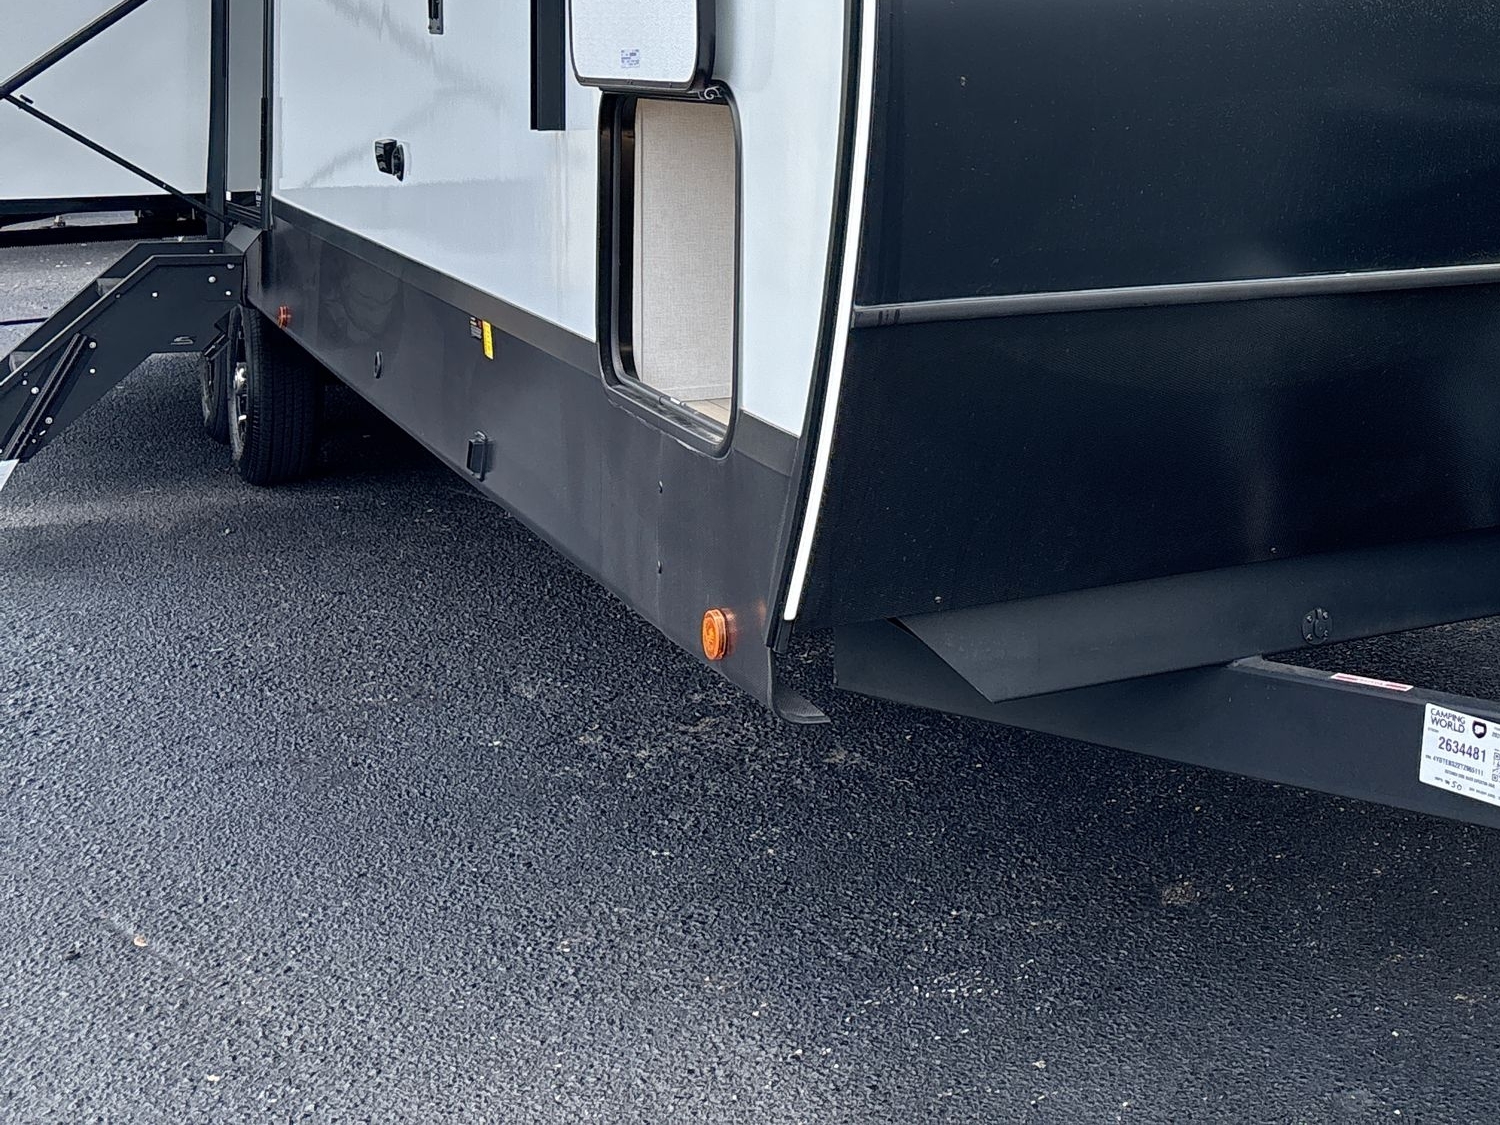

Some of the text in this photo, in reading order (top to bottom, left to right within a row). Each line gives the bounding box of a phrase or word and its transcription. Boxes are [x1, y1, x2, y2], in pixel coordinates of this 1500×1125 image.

[1430, 707, 1466, 725] CAMPING
[1430, 716, 1466, 734] WORLD
[1438, 736, 1487, 763] 2634481
